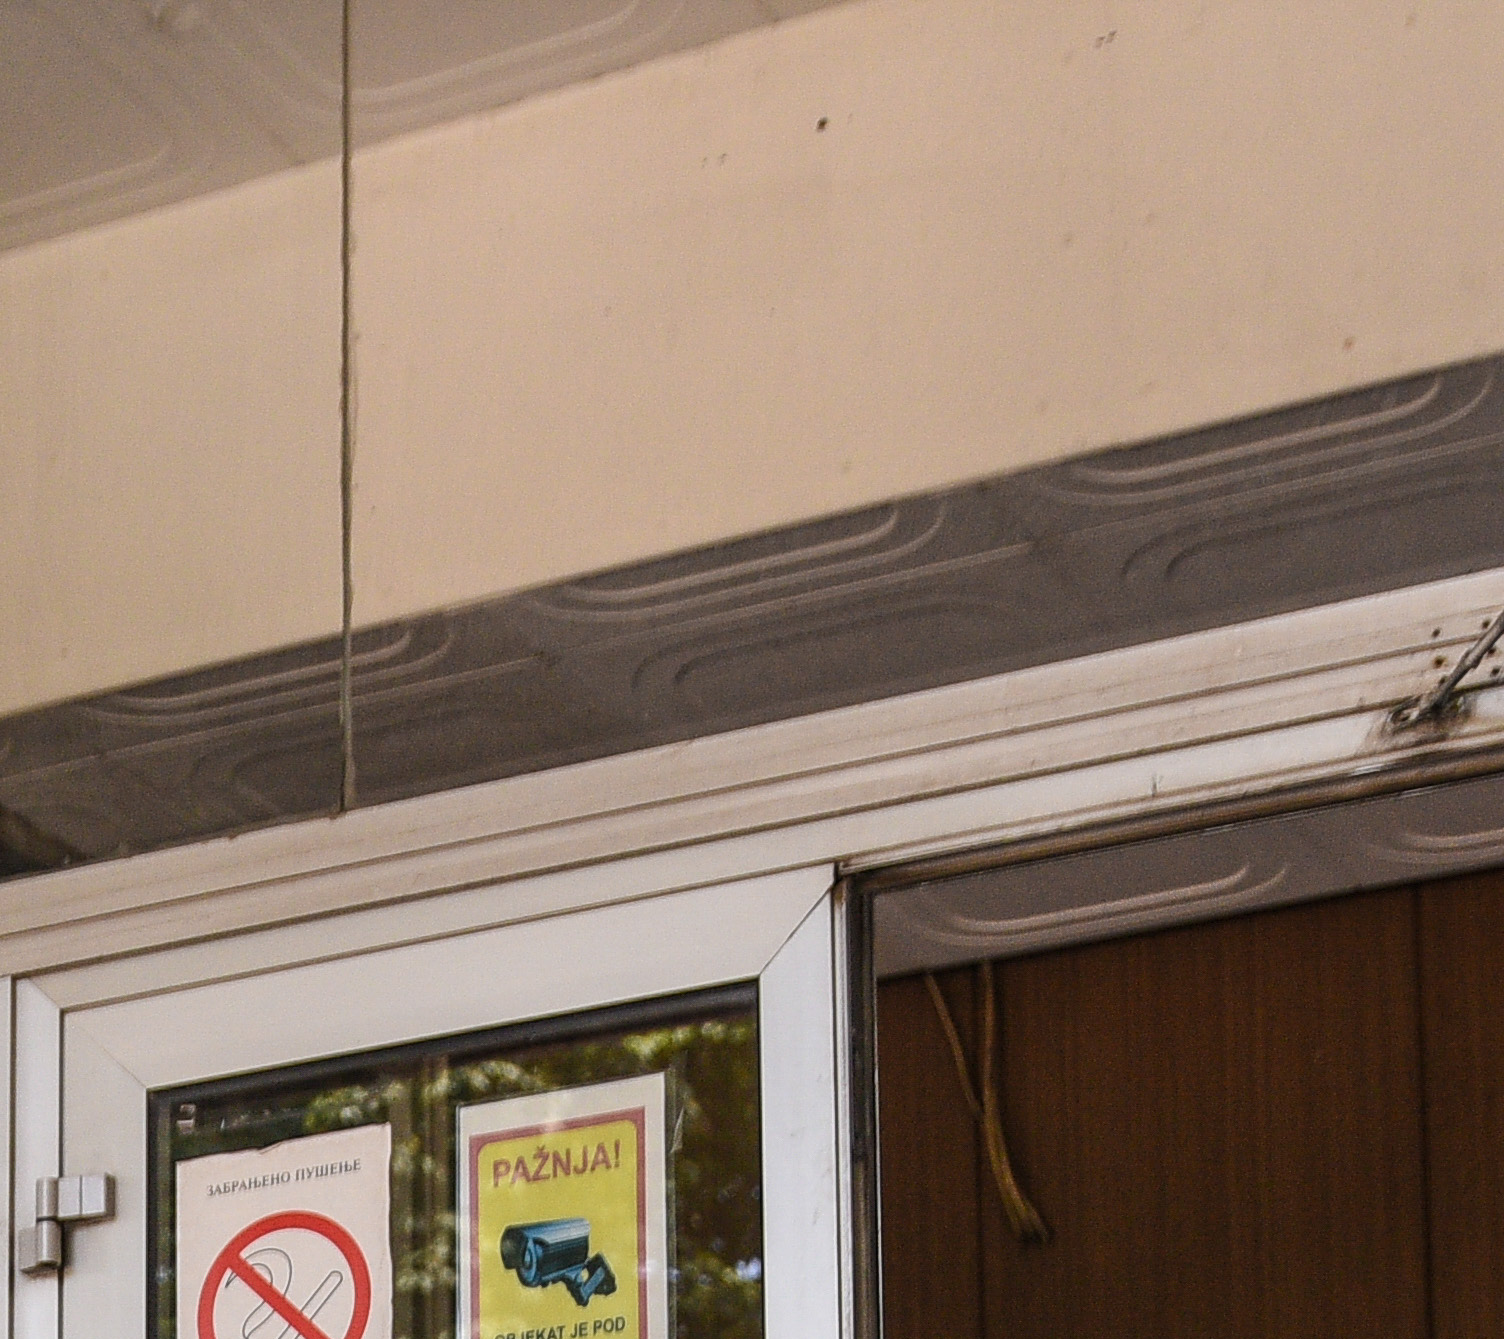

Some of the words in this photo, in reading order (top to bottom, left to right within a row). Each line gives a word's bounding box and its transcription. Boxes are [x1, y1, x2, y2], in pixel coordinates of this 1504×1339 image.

[206, 1170, 292, 1196] ЗАБРАЊЕНО
[295, 1157, 361, 1182] ПУШЕЊЕ
[492, 1139, 622, 1187] PAŽNJA!
[570, 1322, 589, 1339] JE
[593, 1316, 626, 1337] POD
